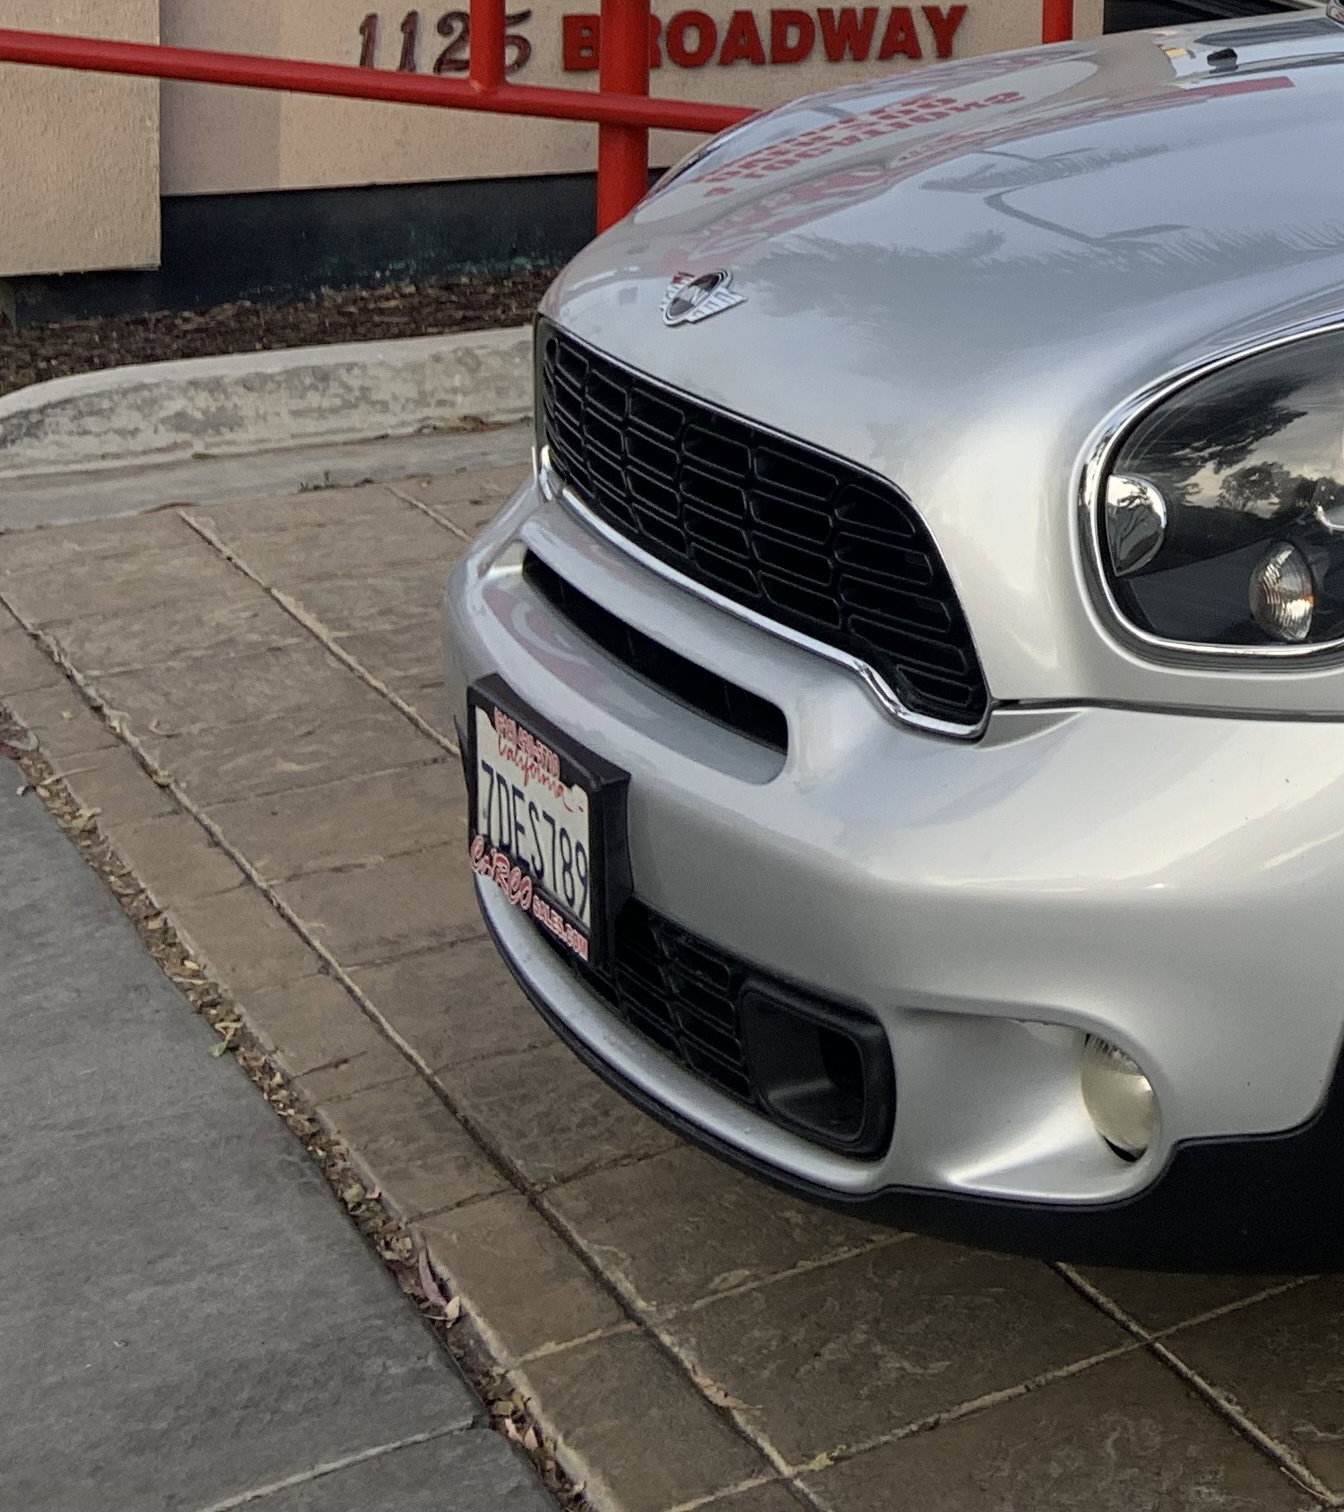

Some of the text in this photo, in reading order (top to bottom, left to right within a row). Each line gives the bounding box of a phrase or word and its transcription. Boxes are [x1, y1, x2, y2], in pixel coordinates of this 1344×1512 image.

[563, 5, 968, 72] BOADWAY
[470, 834, 533, 911] CARCO
[481, 759, 589, 922] 7DES789
